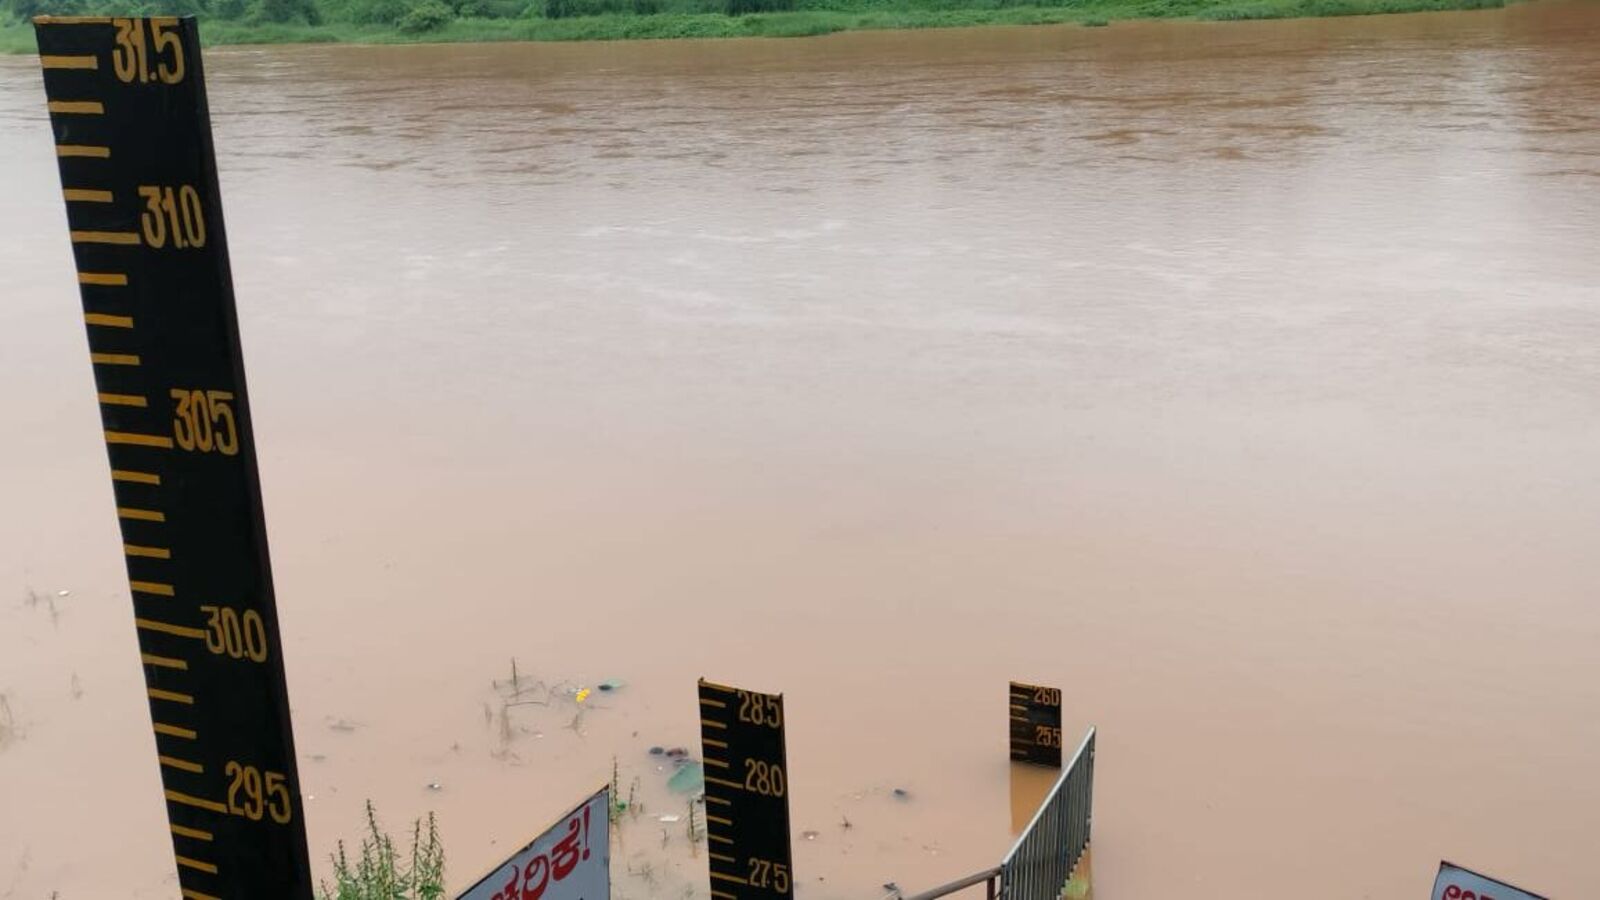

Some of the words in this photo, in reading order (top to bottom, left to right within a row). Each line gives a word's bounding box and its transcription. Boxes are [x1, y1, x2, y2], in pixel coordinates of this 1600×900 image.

[113, 16, 185, 84] 31.5
[200, 605, 267, 663] 30.0
[738, 690, 780, 728] 28.5
[748, 858, 788, 893] 27.5
